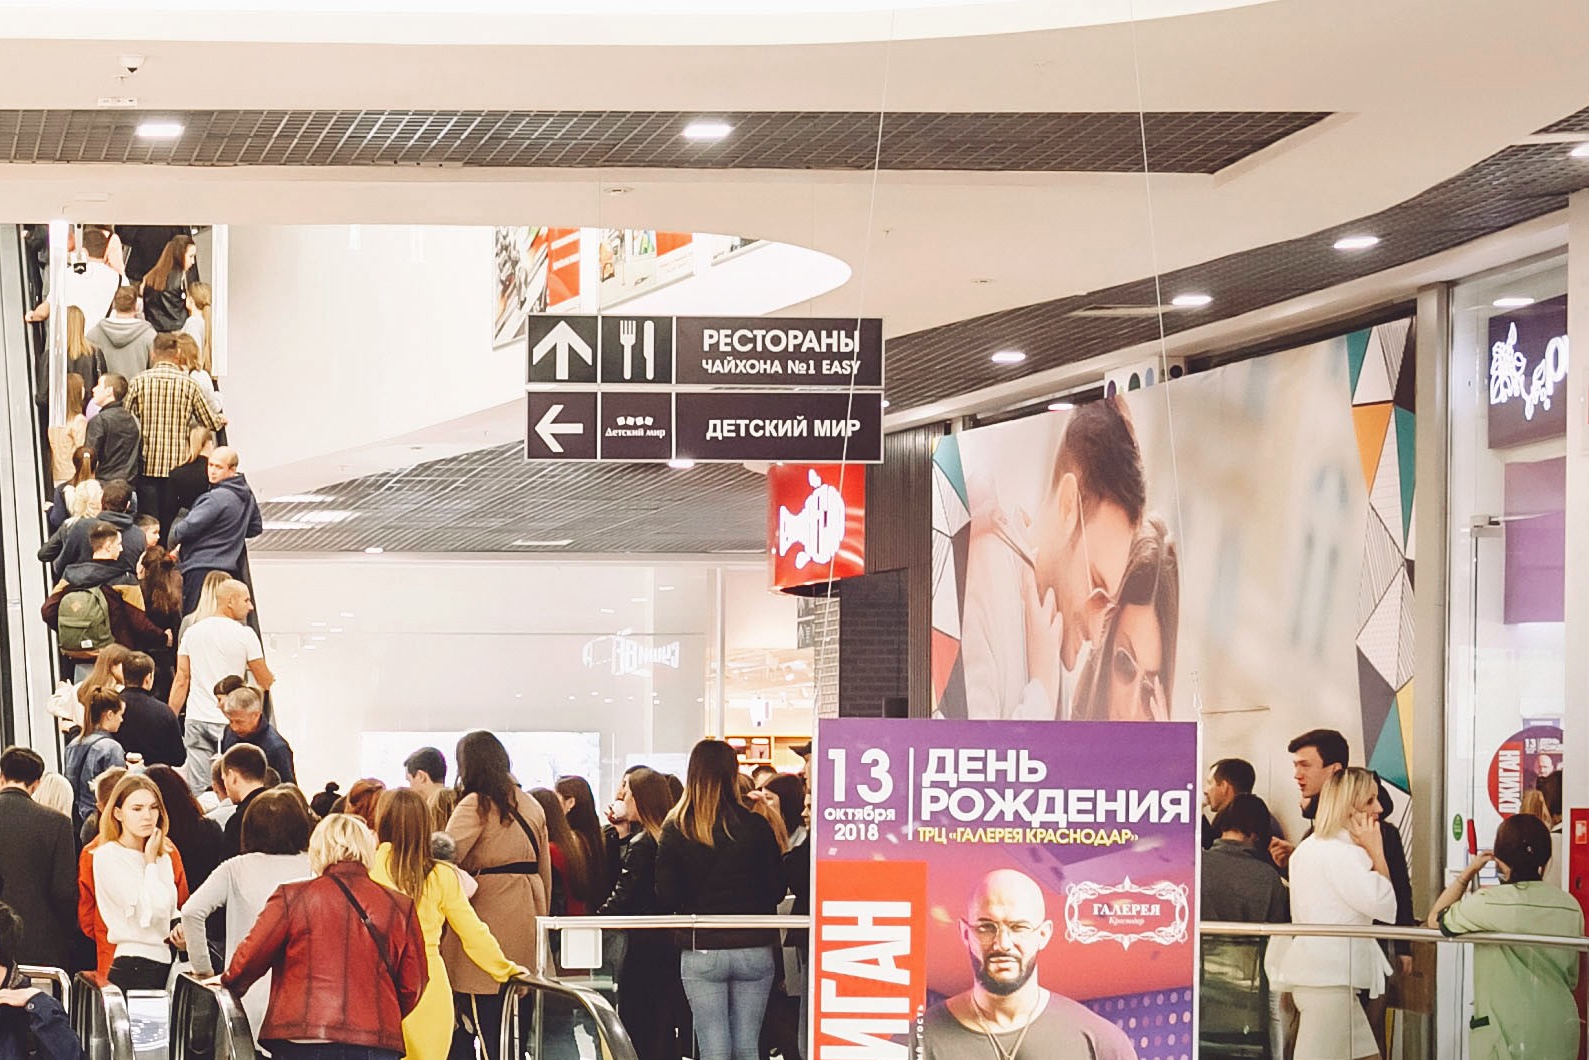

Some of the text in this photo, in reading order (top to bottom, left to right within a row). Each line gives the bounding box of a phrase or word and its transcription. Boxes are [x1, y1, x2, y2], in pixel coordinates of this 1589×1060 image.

[703, 329, 860, 352] РЕСТОРАНЫ
[701, 356, 861, 374] ЧАЙХОНА №1 EASY
[605, 427, 666, 439] Детский мир
[706, 415, 861, 440] ДЕТСКИЙ МИР
[828, 748, 894, 804] 13
[921, 748, 1047, 789] ДЕНЬ
[1498, 750, 1522, 813] ДЖИГАН
[824, 804, 896, 824] октября
[921, 787, 1191, 828] РОЖДЕНИЯ
[834, 823, 879, 841] 2018
[917, 828, 1139, 846] ТРЦ «ГАЛЕРЕЯ КРАСНОДАР»
[1093, 903, 1161, 917] ГАЛЕРЕЯ
[916, 1004, 924, 1039] ГОСТЬ
